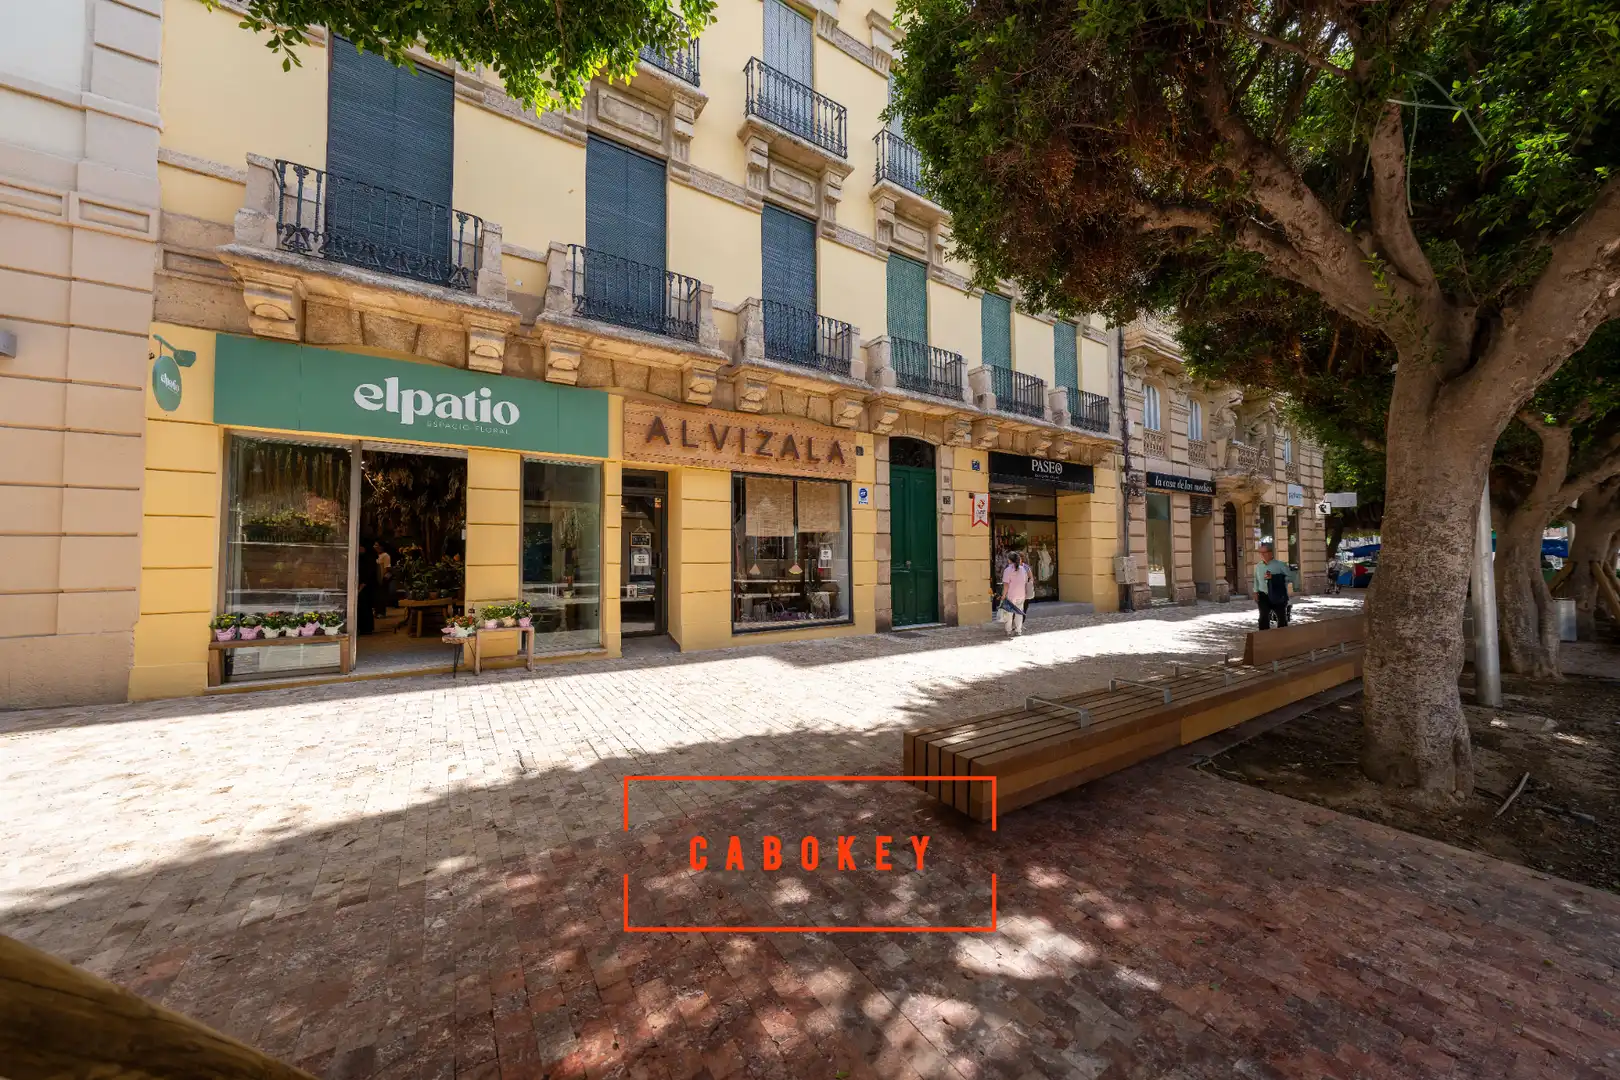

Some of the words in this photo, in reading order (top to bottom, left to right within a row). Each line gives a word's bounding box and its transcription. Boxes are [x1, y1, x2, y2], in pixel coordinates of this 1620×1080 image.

[353, 376, 520, 426] elpatio
[426, 420, 471, 431] ESPACIO
[474, 424, 510, 435] FLORAL
[645, 415, 846, 465] ALVIZALA
[1031, 459, 1063, 475] PASEO
[1155, 475, 1162, 486] la
[1162, 479, 1177, 488] casa
[1177, 478, 1184, 490] de
